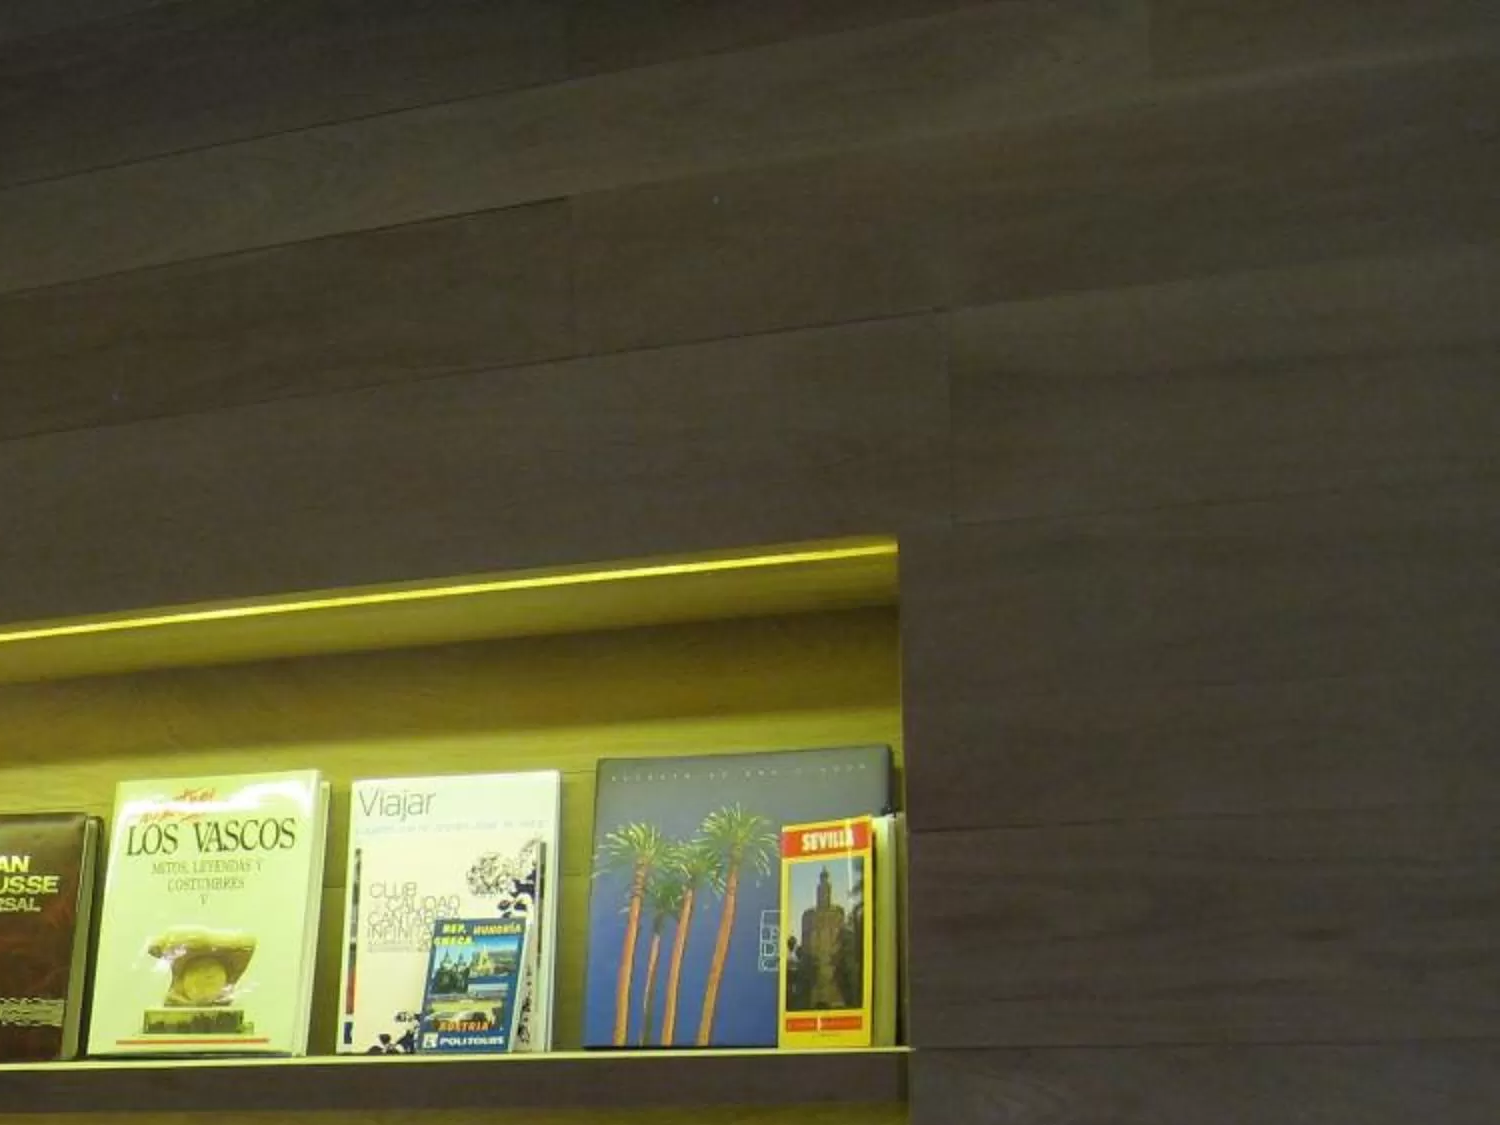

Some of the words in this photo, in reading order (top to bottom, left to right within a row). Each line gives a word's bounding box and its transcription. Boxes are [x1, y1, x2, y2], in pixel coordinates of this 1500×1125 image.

[358, 787, 436, 822] Viajar
[127, 823, 178, 857] LOS
[193, 817, 296, 853] VASCOS
[802, 828, 854, 851] SEVILLA
